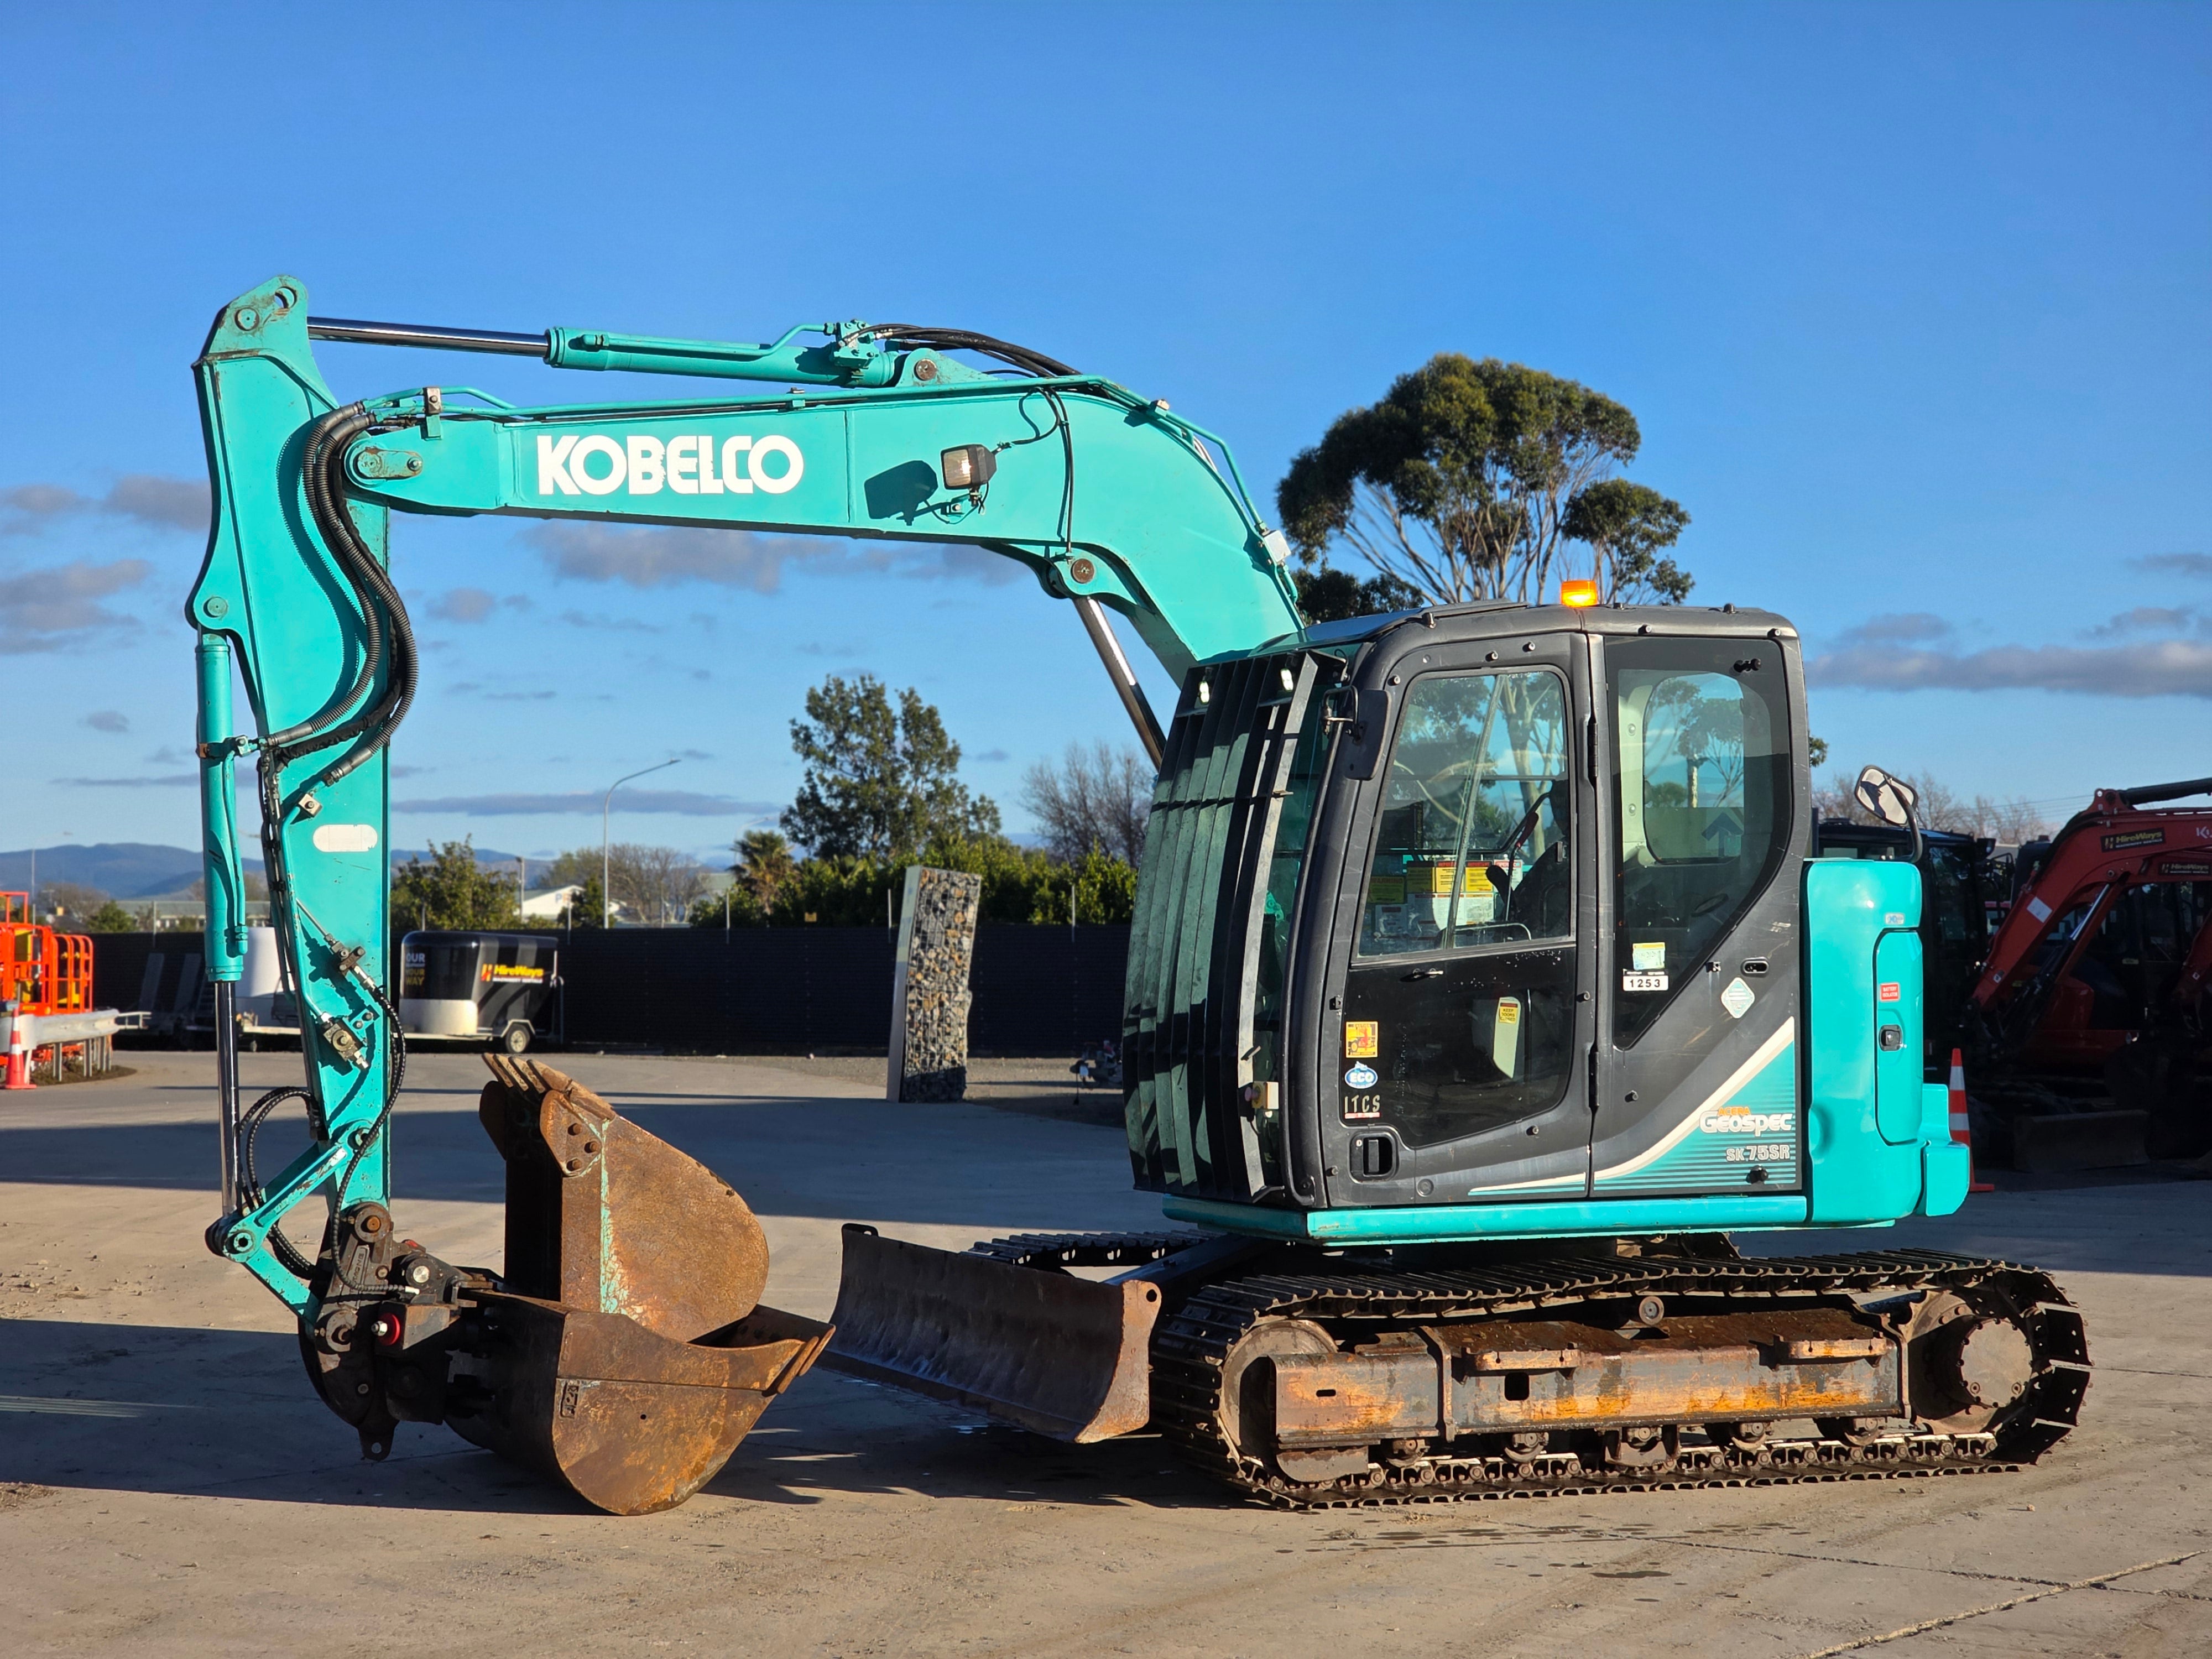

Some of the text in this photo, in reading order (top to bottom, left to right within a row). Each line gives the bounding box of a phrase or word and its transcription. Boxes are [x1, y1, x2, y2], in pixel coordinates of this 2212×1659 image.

[536, 435, 804, 495] KOBELCO
[2116, 831, 2162, 843] HireWays
[406, 952, 425, 962] OUR
[494, 964, 544, 977] HireWays
[406, 976, 425, 986] WAY
[1630, 979, 1660, 988] 1253
[1350, 1072, 1375, 1083] ECO
[1345, 1095, 1380, 1113] ITCS
[1718, 1107, 1751, 1116] ACERA
